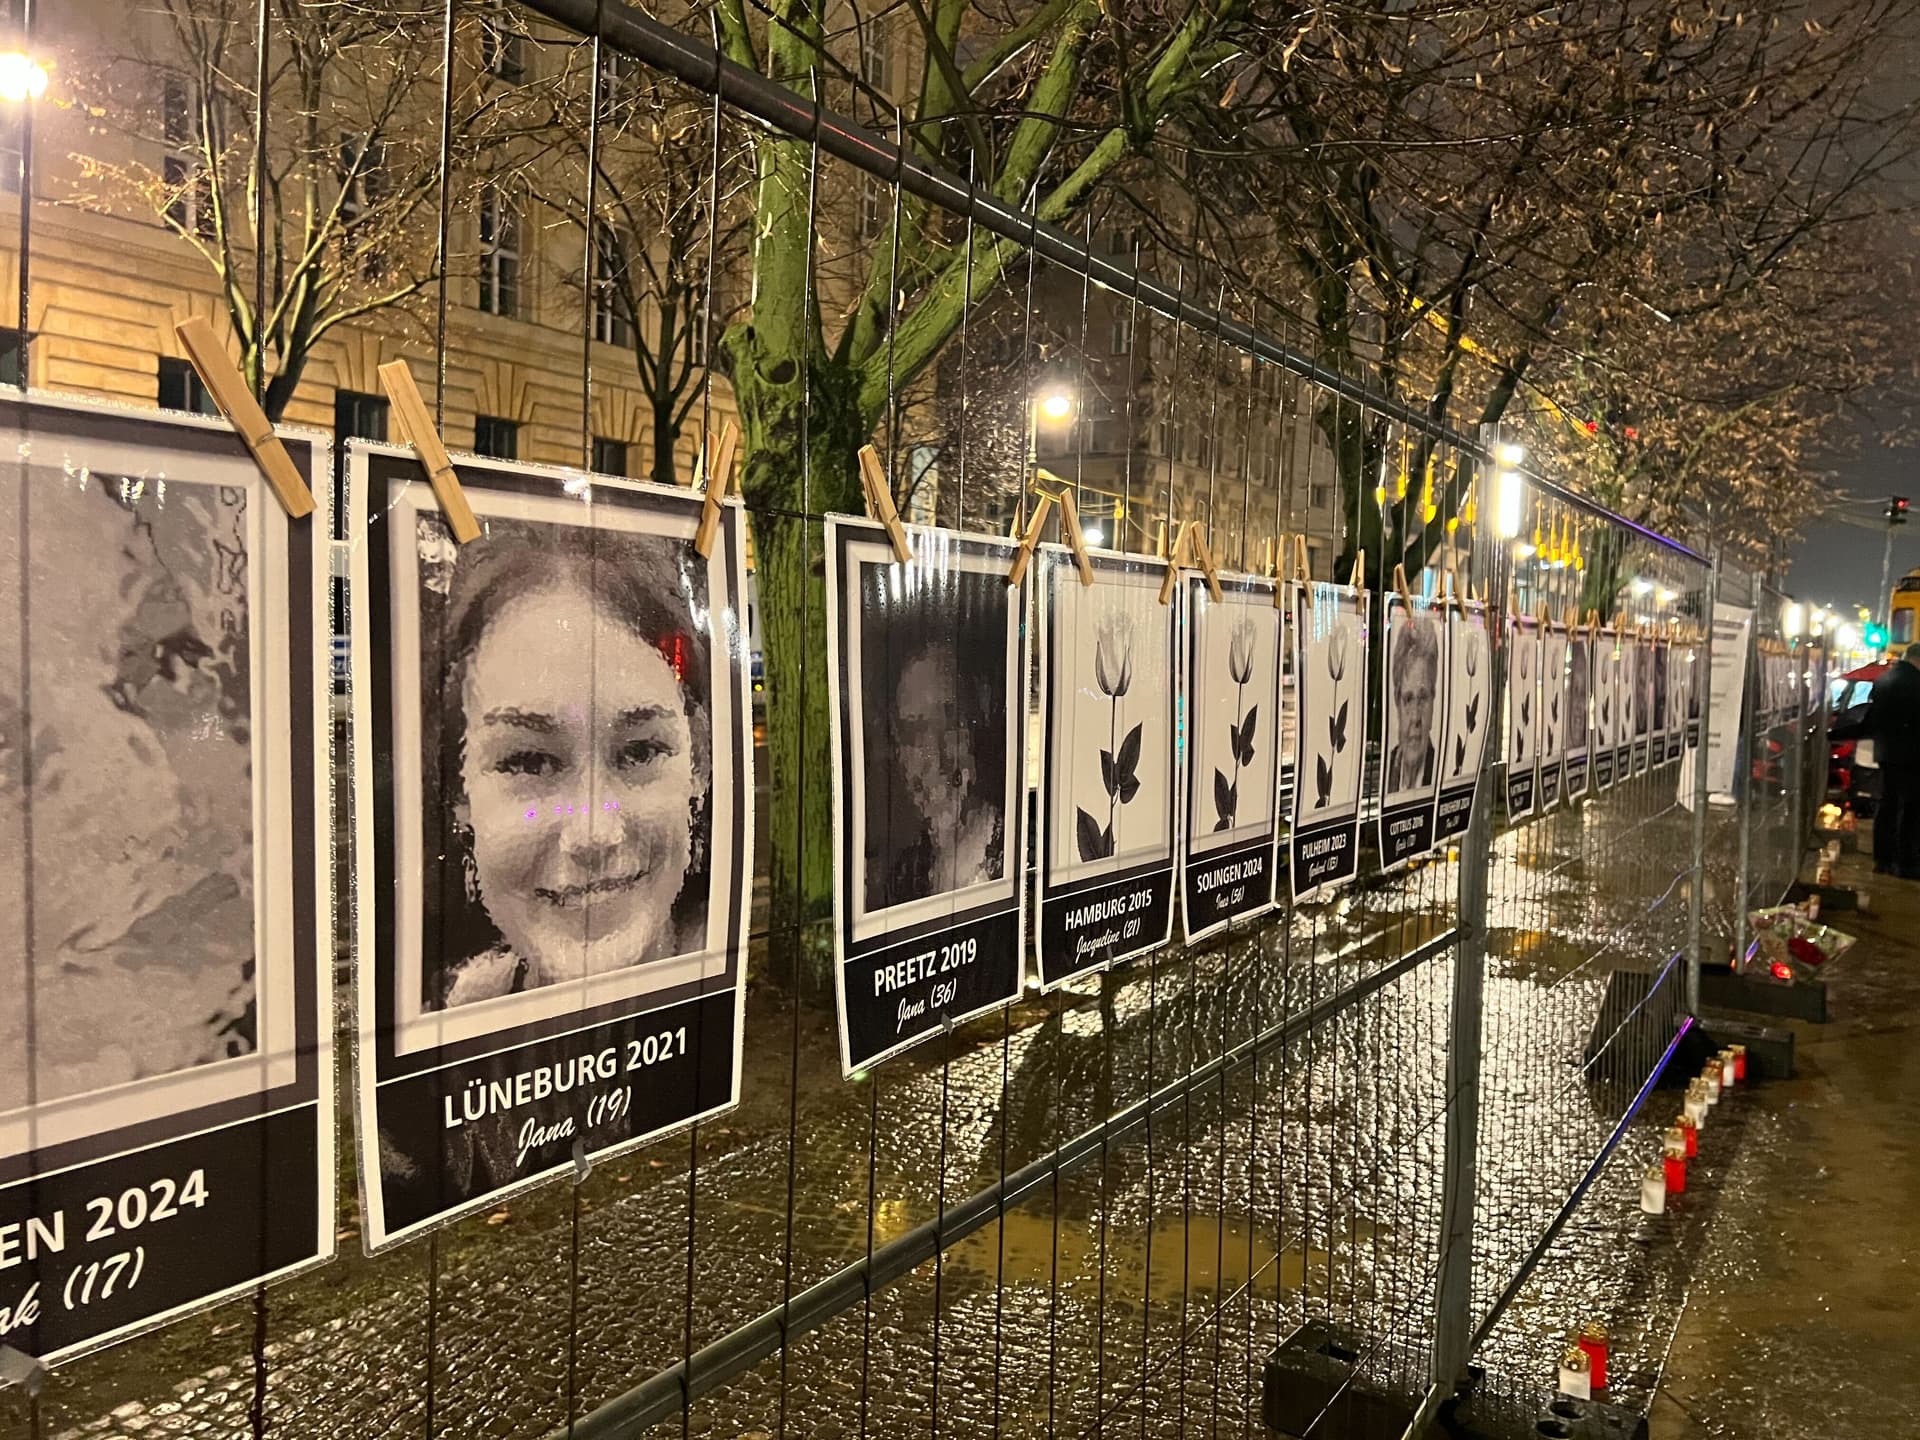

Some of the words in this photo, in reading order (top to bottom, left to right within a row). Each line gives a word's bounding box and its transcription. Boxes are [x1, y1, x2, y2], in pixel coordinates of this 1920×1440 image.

[1197, 863, 1241, 893] SOLINGEN
[1243, 857, 1262, 878] 2024
[1065, 896, 1126, 931] HAMBURG
[1128, 889, 1152, 911] 2015
[1123, 917, 1140, 939] (21)
[874, 951, 937, 997] PREETZ
[941, 938, 977, 972] 2019
[897, 998, 925, 1034] Jana
[931, 977, 957, 1008] (36)
[445, 1047, 617, 1128] LÜNEBURG
[626, 1027, 686, 1071] 2021
[516, 1117, 575, 1167] Jana
[587, 1085, 631, 1128] (19)
[0, 1210, 65, 1270] EN
[86, 1168, 209, 1242] 2024
[63, 1246, 145, 1310] (17)
